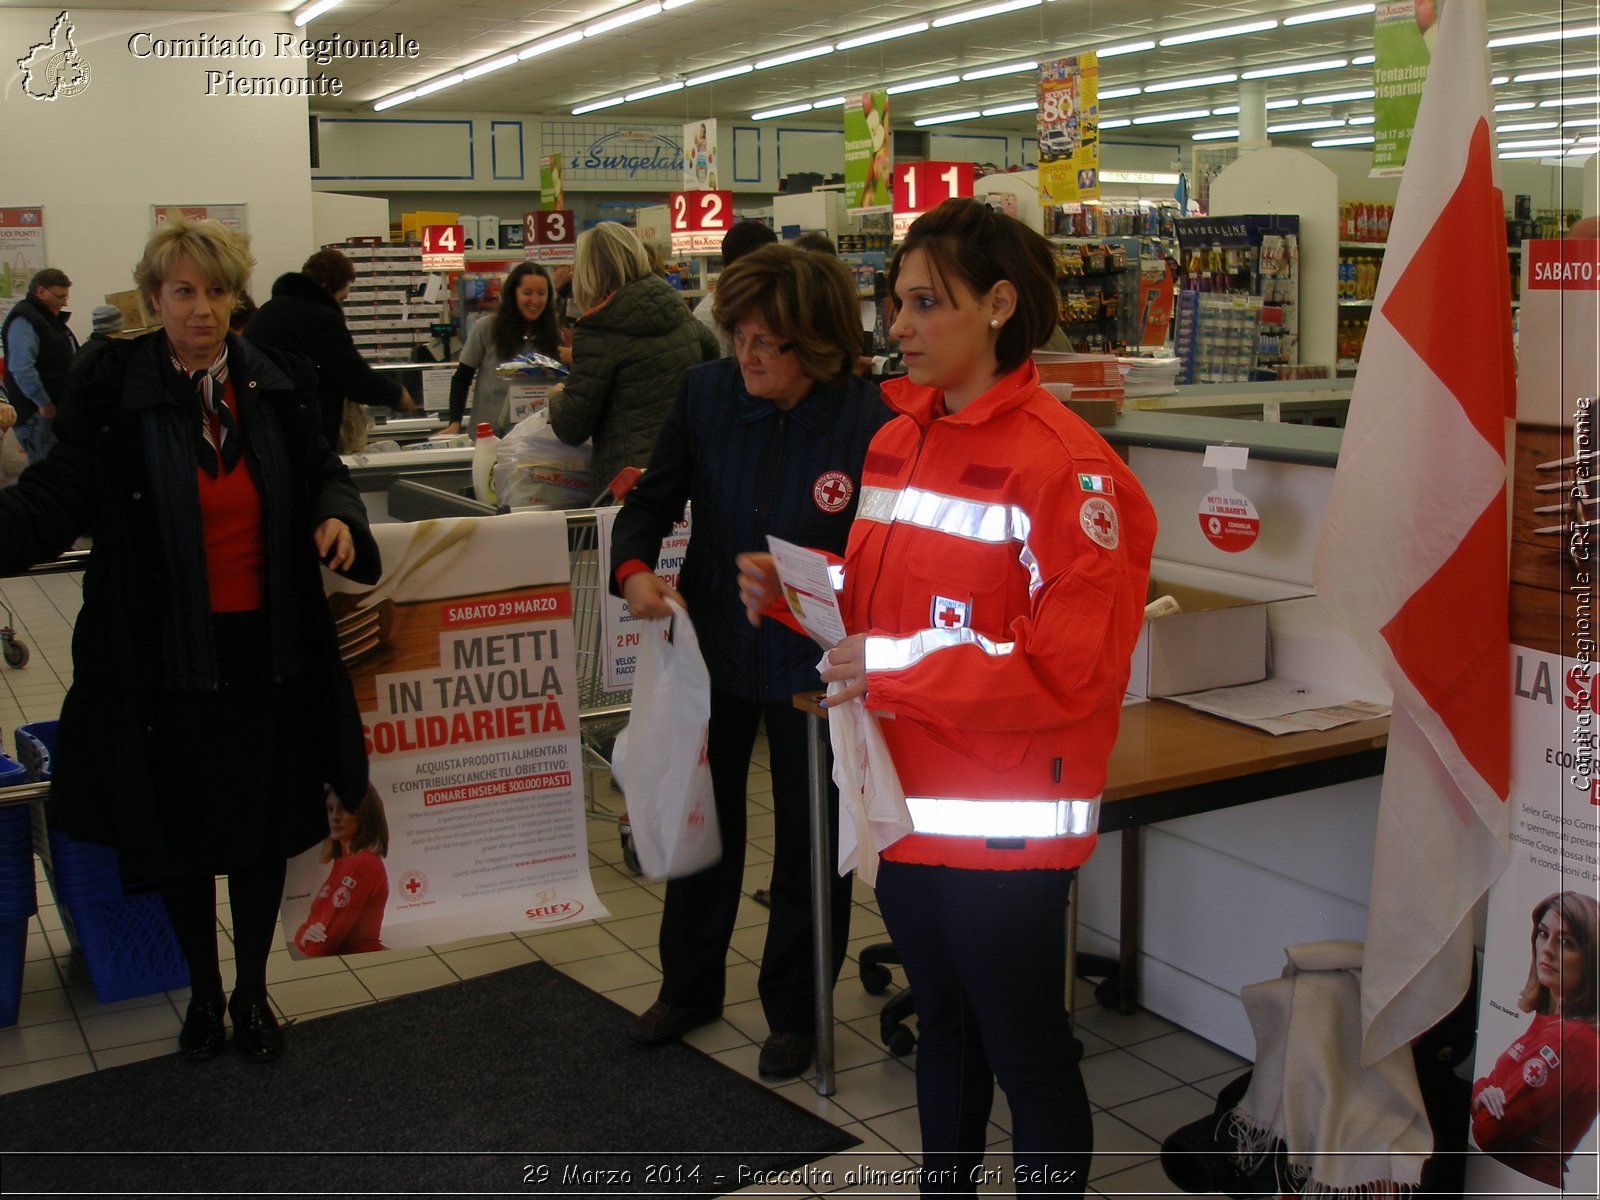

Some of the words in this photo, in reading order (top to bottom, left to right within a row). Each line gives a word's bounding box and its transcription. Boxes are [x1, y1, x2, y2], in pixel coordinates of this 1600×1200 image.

[1374, 66, 1426, 83] Tentazion
[1374, 81, 1423, 98] risparmi
[1044, 95, 1073, 121] 80
[1375, 142, 1397, 151] marzo
[1375, 153, 1391, 163] 2014
[903, 167, 916, 208] 1
[941, 167, 958, 199] 1
[675, 195, 687, 229] 2
[701, 193, 723, 228] 2
[526, 214, 535, 242] 3
[547, 212, 566, 241] 3
[1179, 225, 1247, 235] MAYBELLINE
[424, 228, 430, 252] 4
[439, 227, 457, 252] 4
[1535, 262, 1592, 280] SABATO
[449, 604, 496, 622] SABATO
[499, 602, 512, 616] 29
[515, 597, 558, 613] MARZO
[454, 629, 559, 670] METTI
[617, 635, 624, 648] 2
[626, 634, 640, 646] PU
[615, 656, 637, 666] VELOC
[389, 680, 422, 714] IN
[433, 666, 563, 708] TAVOLA
[1514, 655, 1553, 705] LA
[416, 757, 461, 775] ACQUISTA
[463, 752, 509, 769] PRODOTTI
[511, 744, 567, 760] ALIMENTARI
[1545, 748, 1553, 764] E
[392, 783, 399, 793] E
[400, 773, 467, 792] CONTRIBUISCI
[467, 769, 497, 784] ANCHE
[516, 759, 569, 775] OBIETTIVO:
[427, 788, 467, 804] DONARE
[469, 782, 507, 798] INSIEME
[509, 777, 541, 792] 300.000
[543, 773, 571, 788] PASTI
[1522, 803, 1540, 817] Selex
[1541, 810, 1573, 825] Gruppo
[1508, 833, 1536, 849] ostiene
[1536, 841, 1559, 856] Croce
[1581, 870, 1590, 880] di
[526, 902, 571, 919] SELEX
